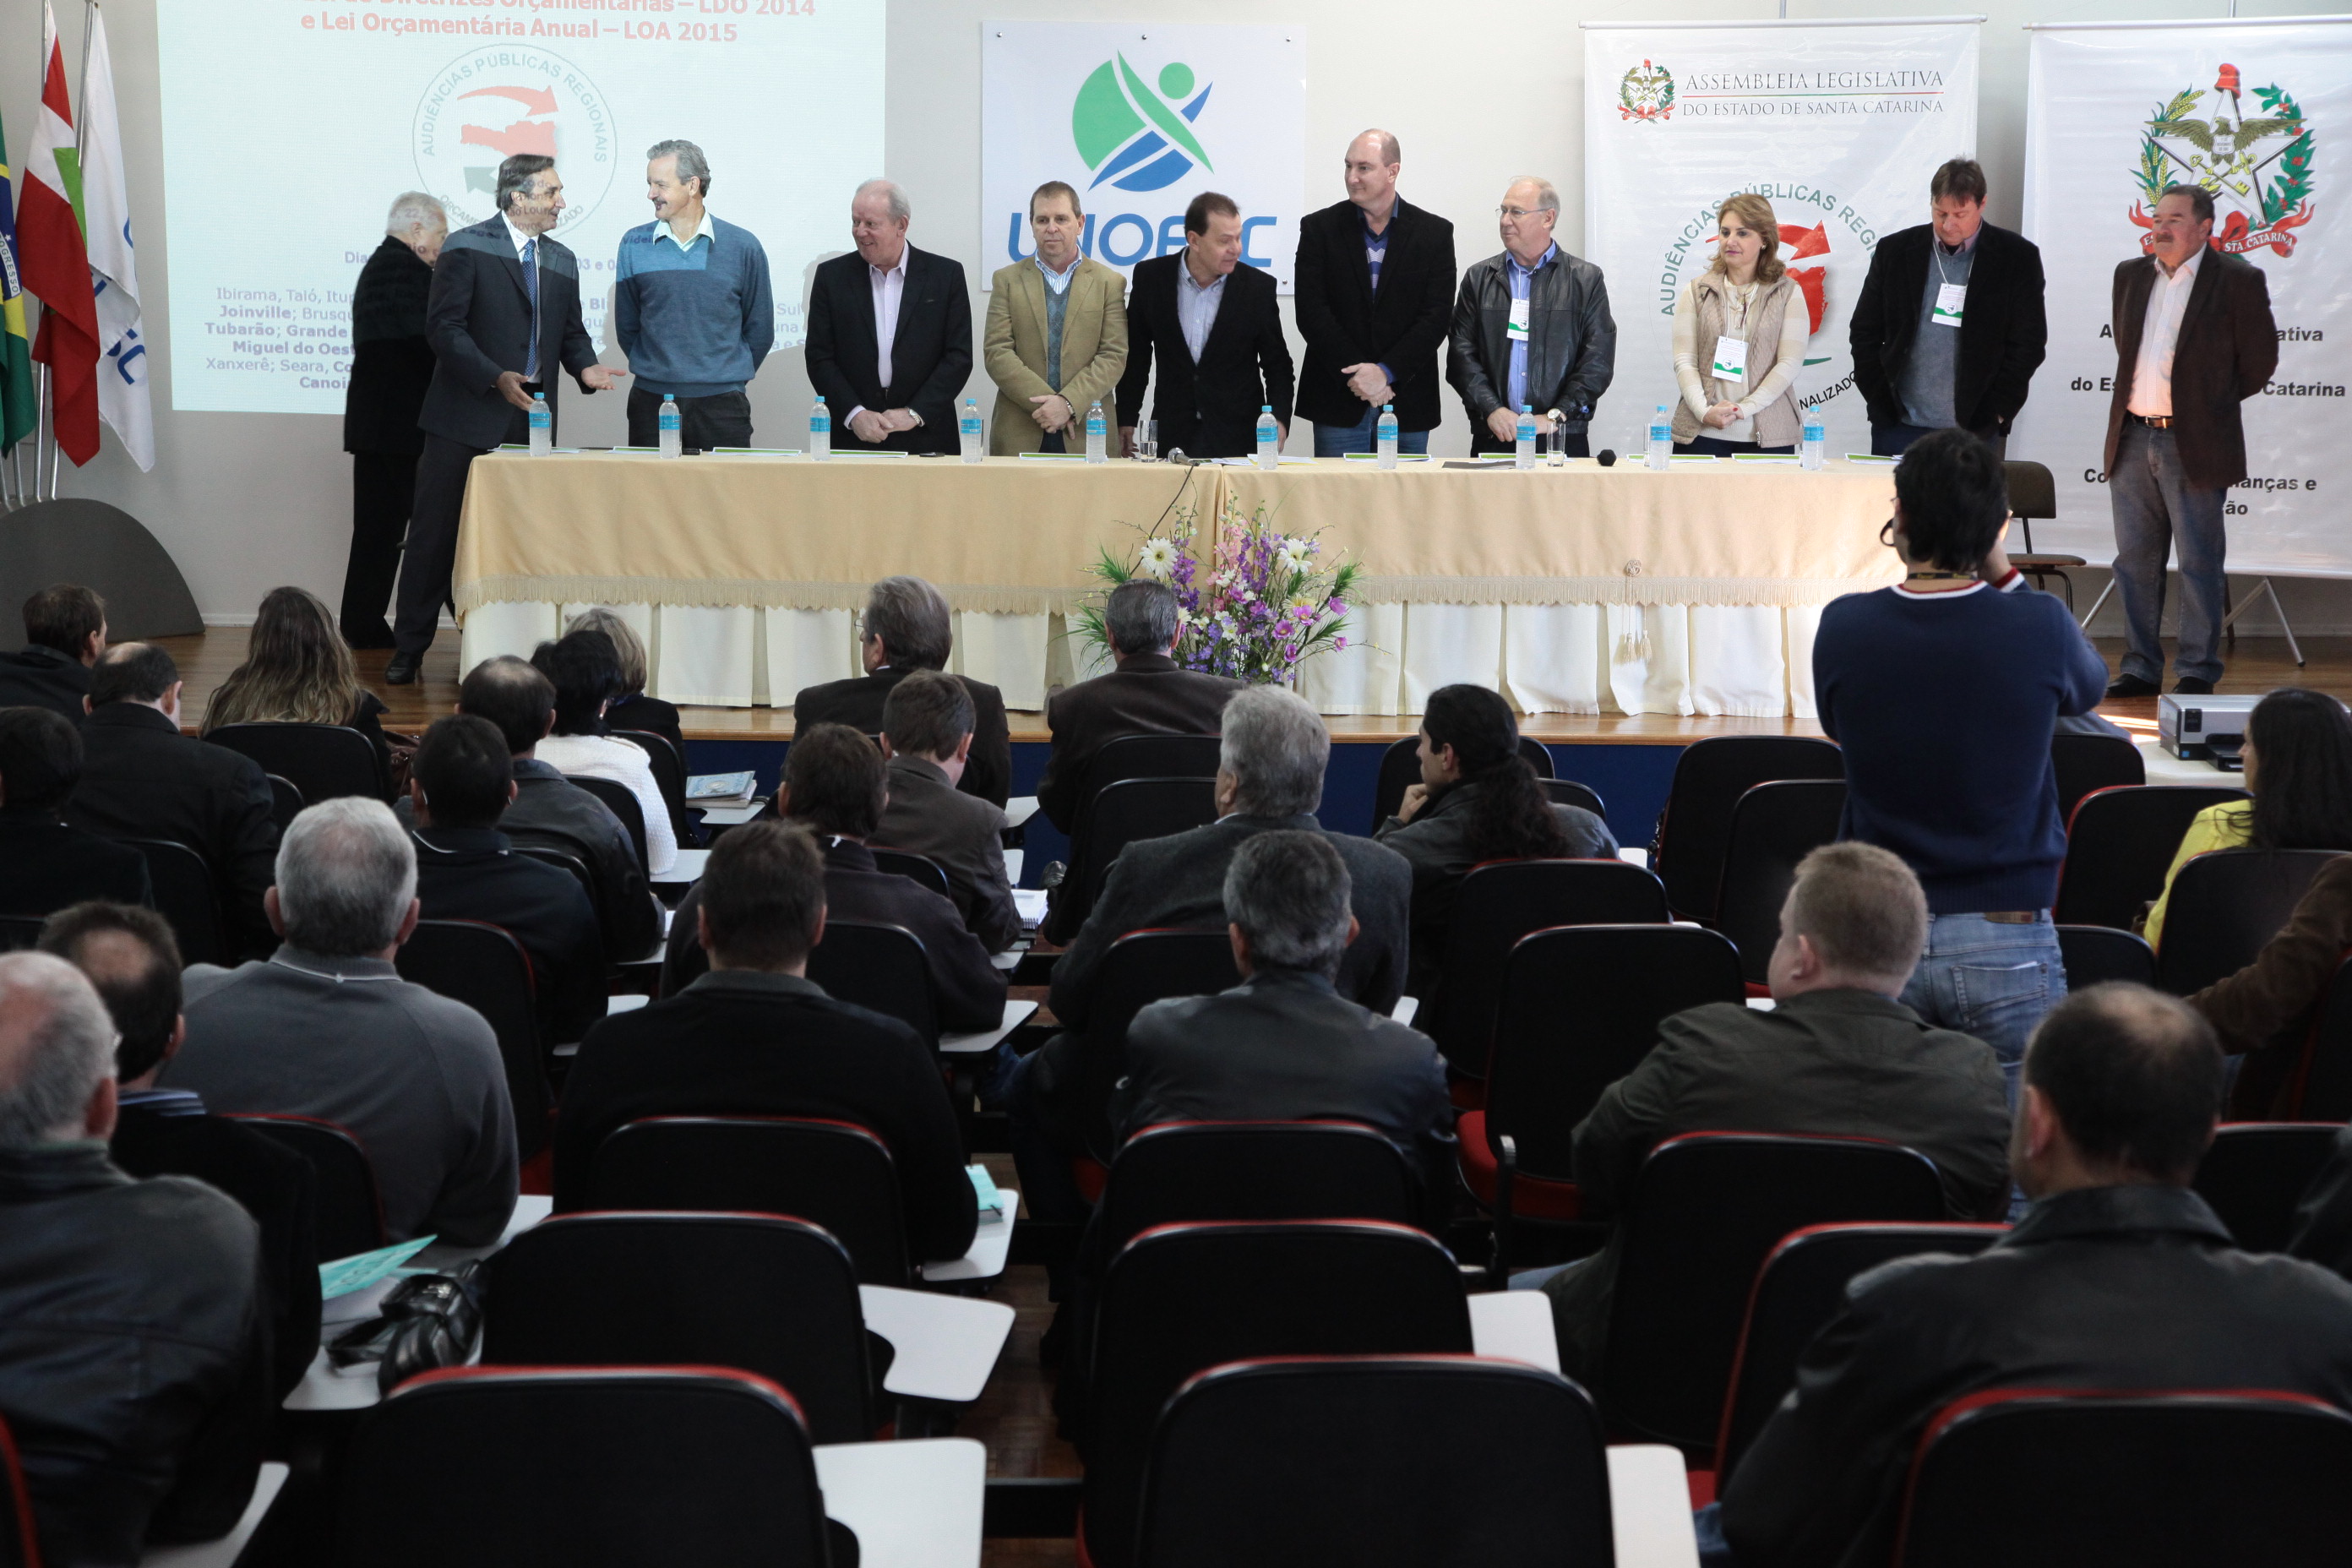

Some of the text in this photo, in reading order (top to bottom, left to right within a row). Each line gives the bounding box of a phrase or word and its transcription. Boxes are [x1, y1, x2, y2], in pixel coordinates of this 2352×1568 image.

[755, 0, 816, 16] 2014
[301, 14, 315, 29] e
[321, 11, 356, 30] Lei
[362, 13, 525, 36] Orçamentária
[530, 18, 598, 38] Anual
[623, 20, 672, 41] LOA
[678, 22, 738, 42] 2015
[1684, 70, 1945, 91] ASSEMBLEIA LEGISLATIVA
[422, 52, 607, 163] AUDIÊNCIAS PÚBLICAS REGIONAIS
[1682, 102, 1709, 117] DO
[1713, 101, 1775, 117] ESTADO
[1780, 101, 1801, 116] DE
[1806, 101, 1858, 115] SANTA
[1863, 100, 1944, 114] CATARINA
[2246, 231, 2294, 248] CATARINA
[0, 241, 19, 293] OGRESSO
[1660, 199, 1723, 317] AUDIÊNCIAS
[216, 287, 281, 303] Ibirama,
[220, 305, 353, 323] Joinville; Brusqu
[205, 321, 348, 339] Tubarão; Grande
[232, 340, 356, 356] Miguel do Oest
[206, 357, 275, 373] Xanxerê;
[280, 359, 329, 374] Seara,
[2071, 377, 2093, 391] do
[2263, 380, 2345, 397] Catarina
[2305, 479, 2317, 490] e
